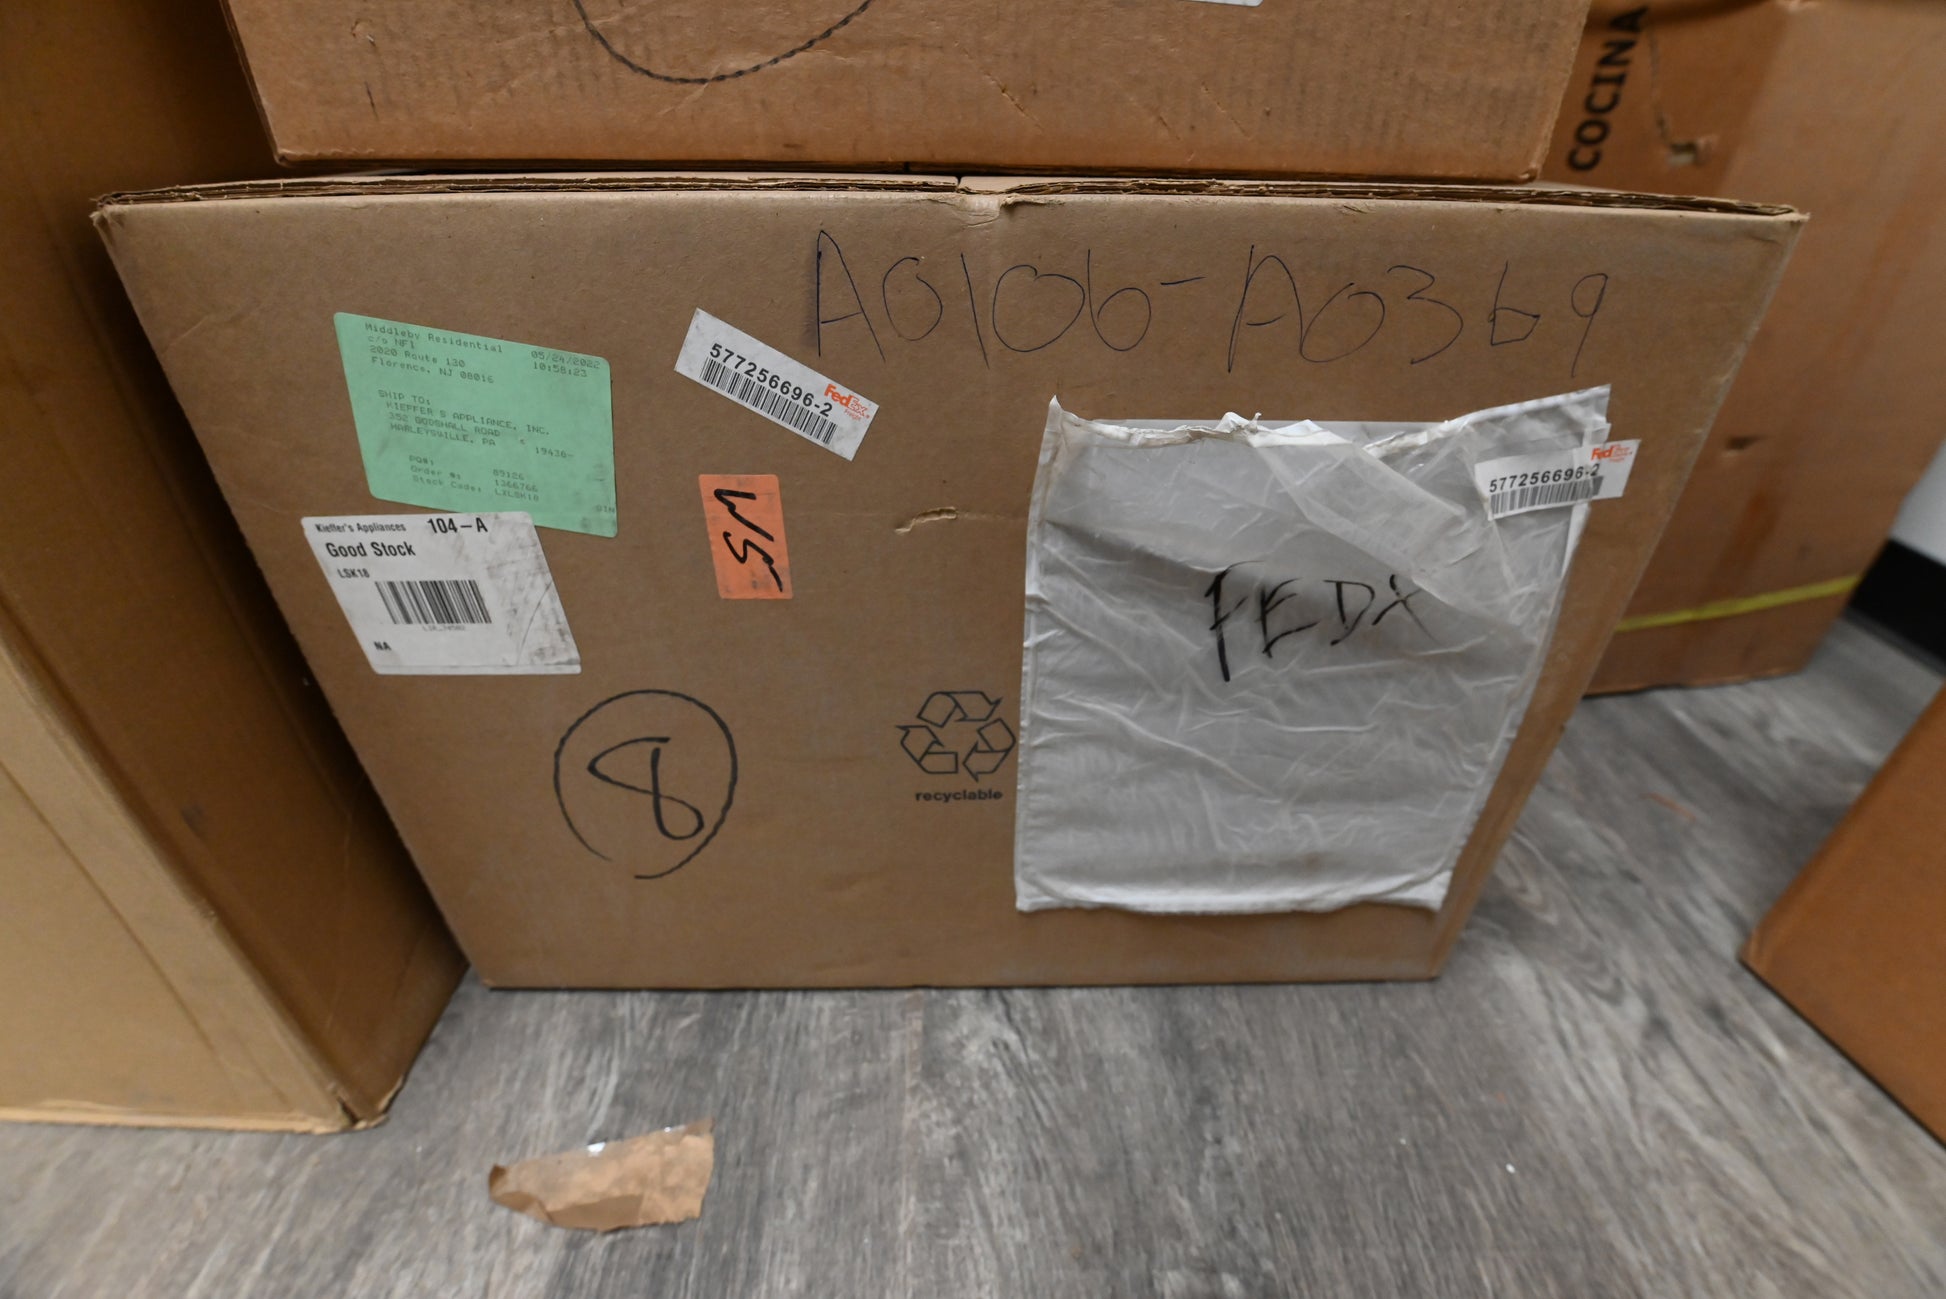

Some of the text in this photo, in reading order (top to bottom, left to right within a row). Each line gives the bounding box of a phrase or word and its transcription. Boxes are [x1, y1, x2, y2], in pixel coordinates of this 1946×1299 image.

[1567, 3, 1649, 172] COCINA
[427, 333, 502, 353] Residential
[369, 344, 466, 369] 2020 Route 130
[530, 349, 601, 369] 05/24/2022
[438, 367, 453, 378] NJ
[709, 342, 869, 419] 577256696-2 FedEx
[377, 388, 405, 402] SHIP
[385, 399, 434, 417] KIEFFER
[473, 424, 501, 438] ROAD
[481, 435, 496, 447] PA
[410, 464, 443, 477] Order
[1488, 462, 1601, 493] 577256696-2
[412, 474, 444, 487] Stock
[315, 522, 355, 534] Kieffer's
[356, 521, 407, 534] Appliances
[325, 540, 416, 557] Good Stock
[1203, 560, 1437, 682] FEDX
[373, 640, 392, 652] NA
[586, 735, 706, 841] 8
[914, 788, 1004, 804] recyclable
